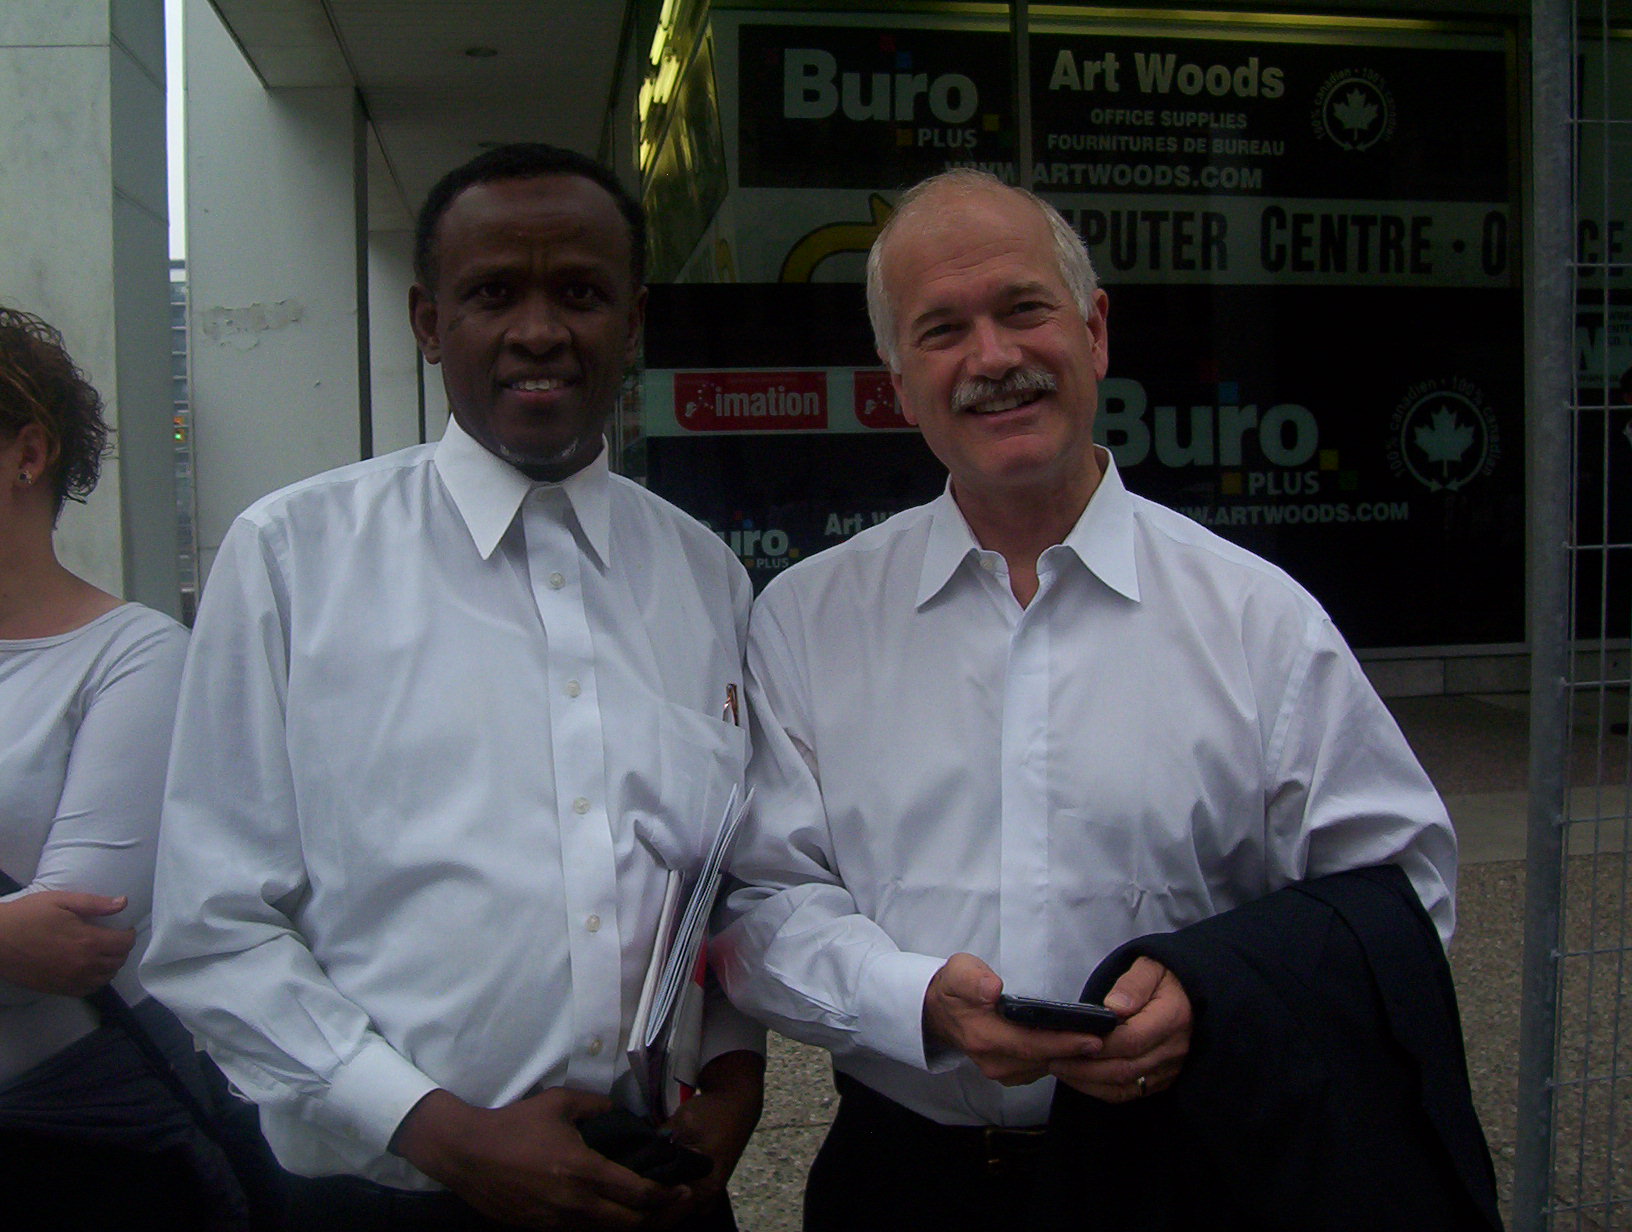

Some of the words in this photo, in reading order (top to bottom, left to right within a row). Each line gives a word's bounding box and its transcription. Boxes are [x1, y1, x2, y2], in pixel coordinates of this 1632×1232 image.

[1048, 49, 1121, 92] Art
[1134, 52, 1286, 99] Woods
[1090, 107, 1155, 127] OFFICE
[1160, 109, 1249, 130] SUPPLIES
[917, 127, 979, 149] PLUS
[1047, 133, 1178, 153] FOURNITURES
[1183, 135, 1206, 154] DE
[1211, 135, 1286, 157] BUREAU
[1061, 208, 1229, 273] PUTER
[1260, 205, 1434, 274] CENTRE
[715, 385, 820, 417] imation
[1248, 470, 1321, 496] PLUS
[823, 512, 864, 536] Art
[756, 556, 790, 570] PLUS
